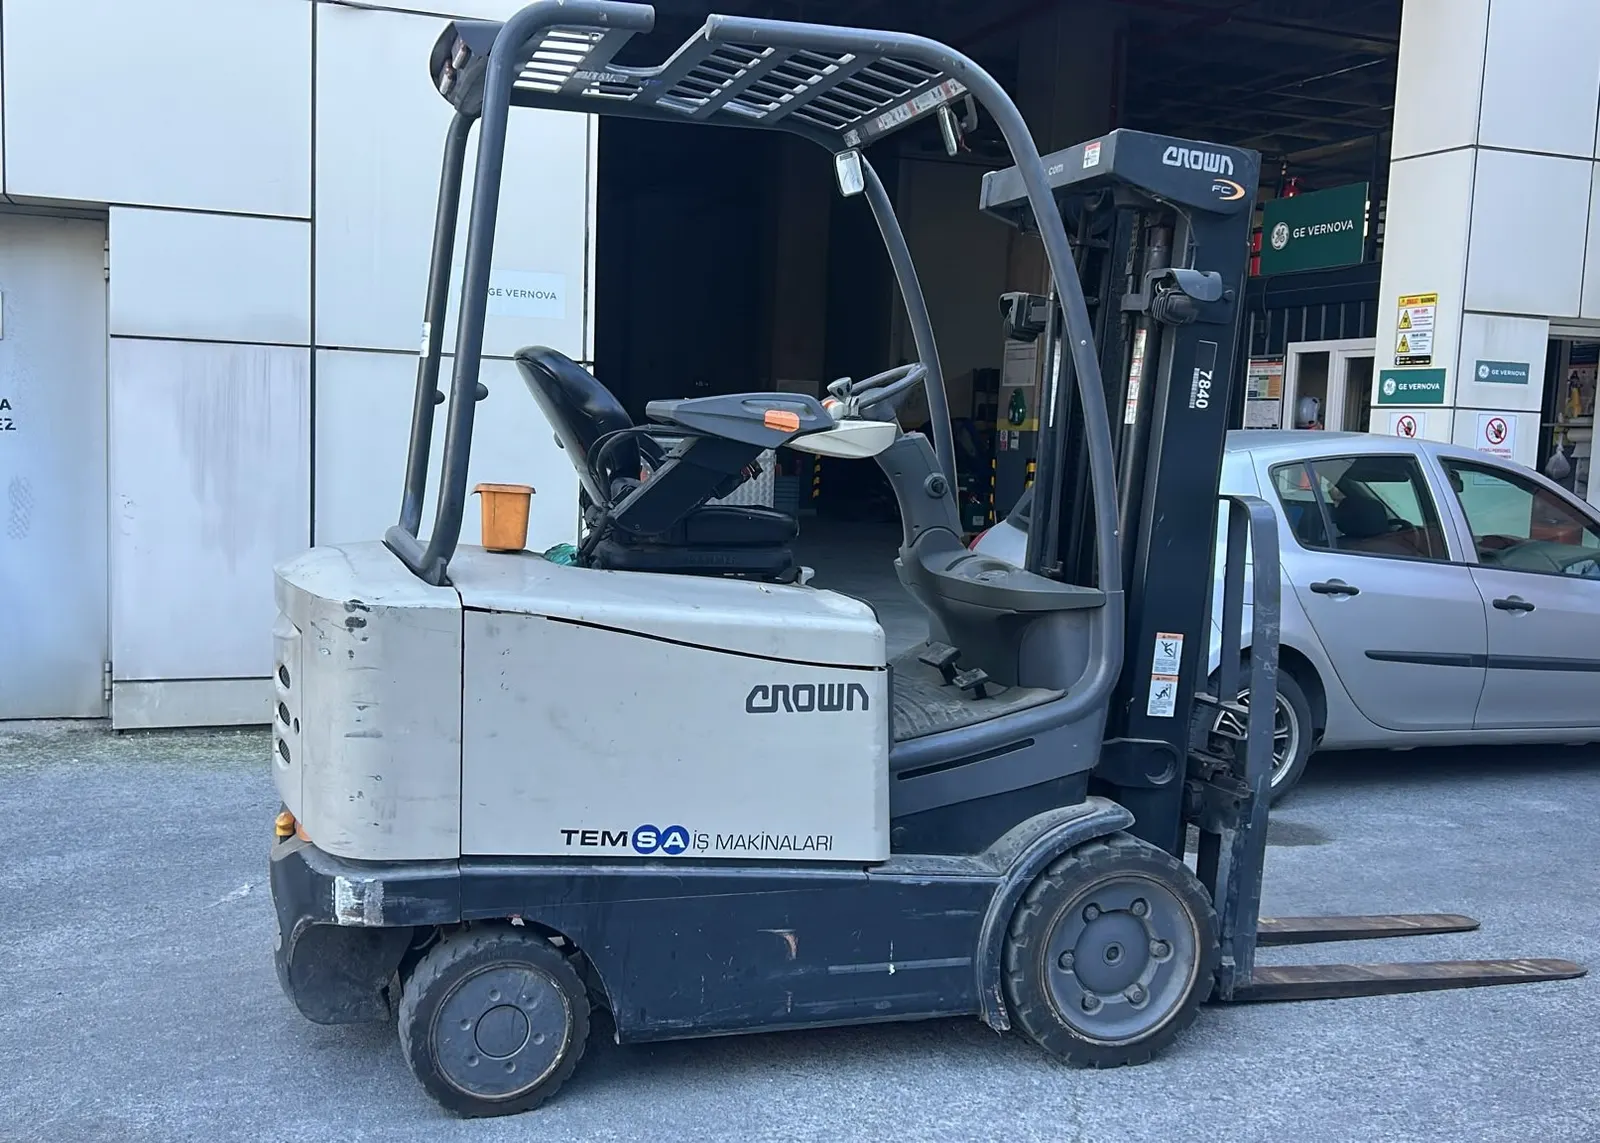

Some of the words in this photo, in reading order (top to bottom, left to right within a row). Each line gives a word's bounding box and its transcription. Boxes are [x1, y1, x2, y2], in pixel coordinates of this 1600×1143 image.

[1162, 146, 1234, 175] CROWN
[1212, 184, 1231, 194] FC
[1293, 227, 1306, 238] GE
[1308, 219, 1354, 236] VERNOVA
[488, 288, 503, 297] GE
[505, 289, 557, 300] VERNOVA
[1195, 370, 1213, 409] 7840
[1408, 382, 1440, 390] VERNOVA
[745, 683, 869, 713] CROWN
[560, 826, 689, 852] TEMSA
[692, 830, 709, 853] İŞ
[715, 831, 833, 851] MAKİNALARI
